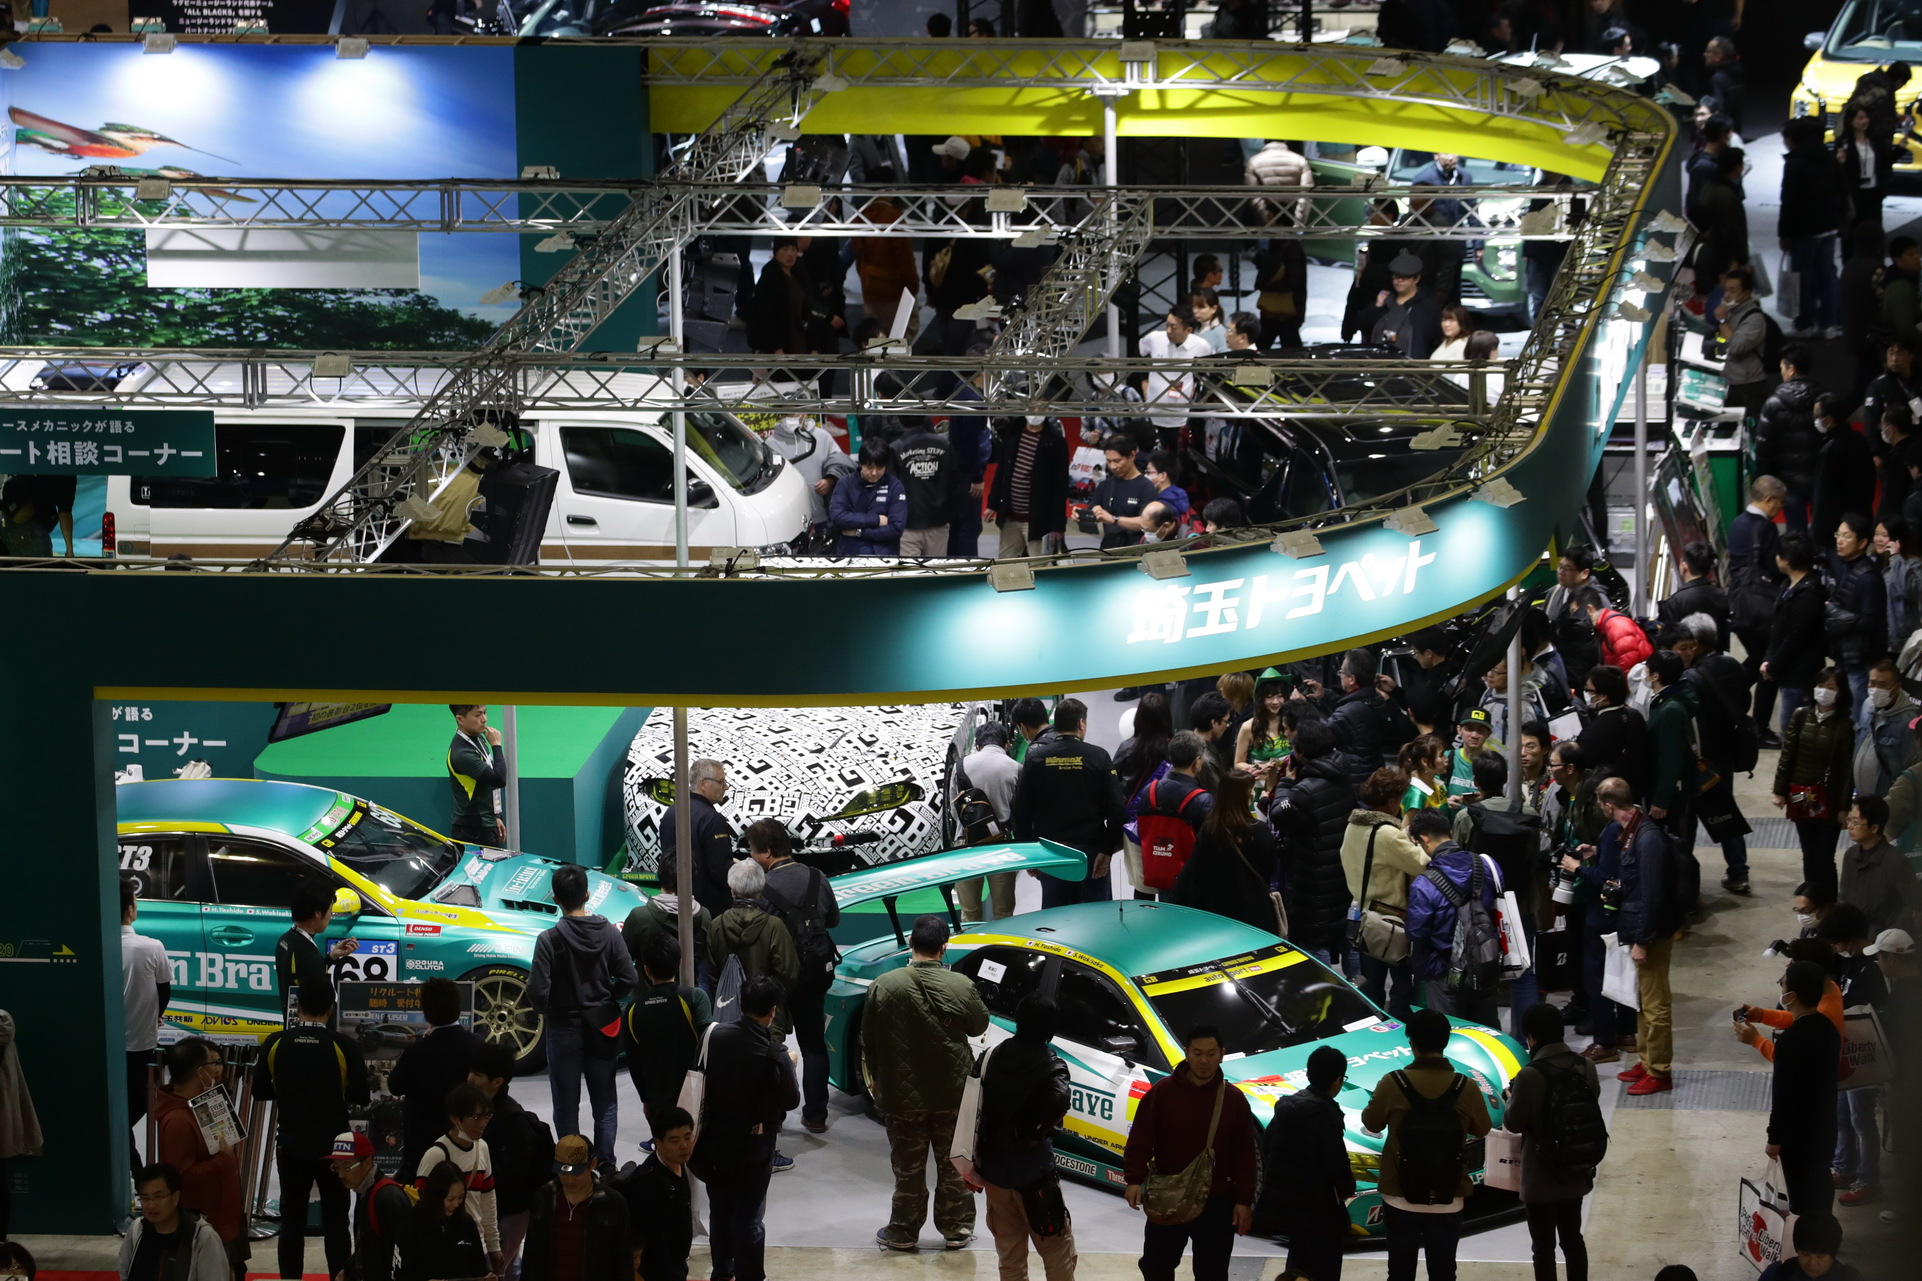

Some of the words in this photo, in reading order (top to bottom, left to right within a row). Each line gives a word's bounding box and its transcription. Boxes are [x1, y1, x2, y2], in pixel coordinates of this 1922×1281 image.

[1126, 540, 1437, 644] 埼玉トヨペット
[118, 731, 227, 756] コーナー
[371, 943, 396, 954] ST3
[195, 951, 277, 991] Bra
[1068, 1088, 1114, 1121] ave
